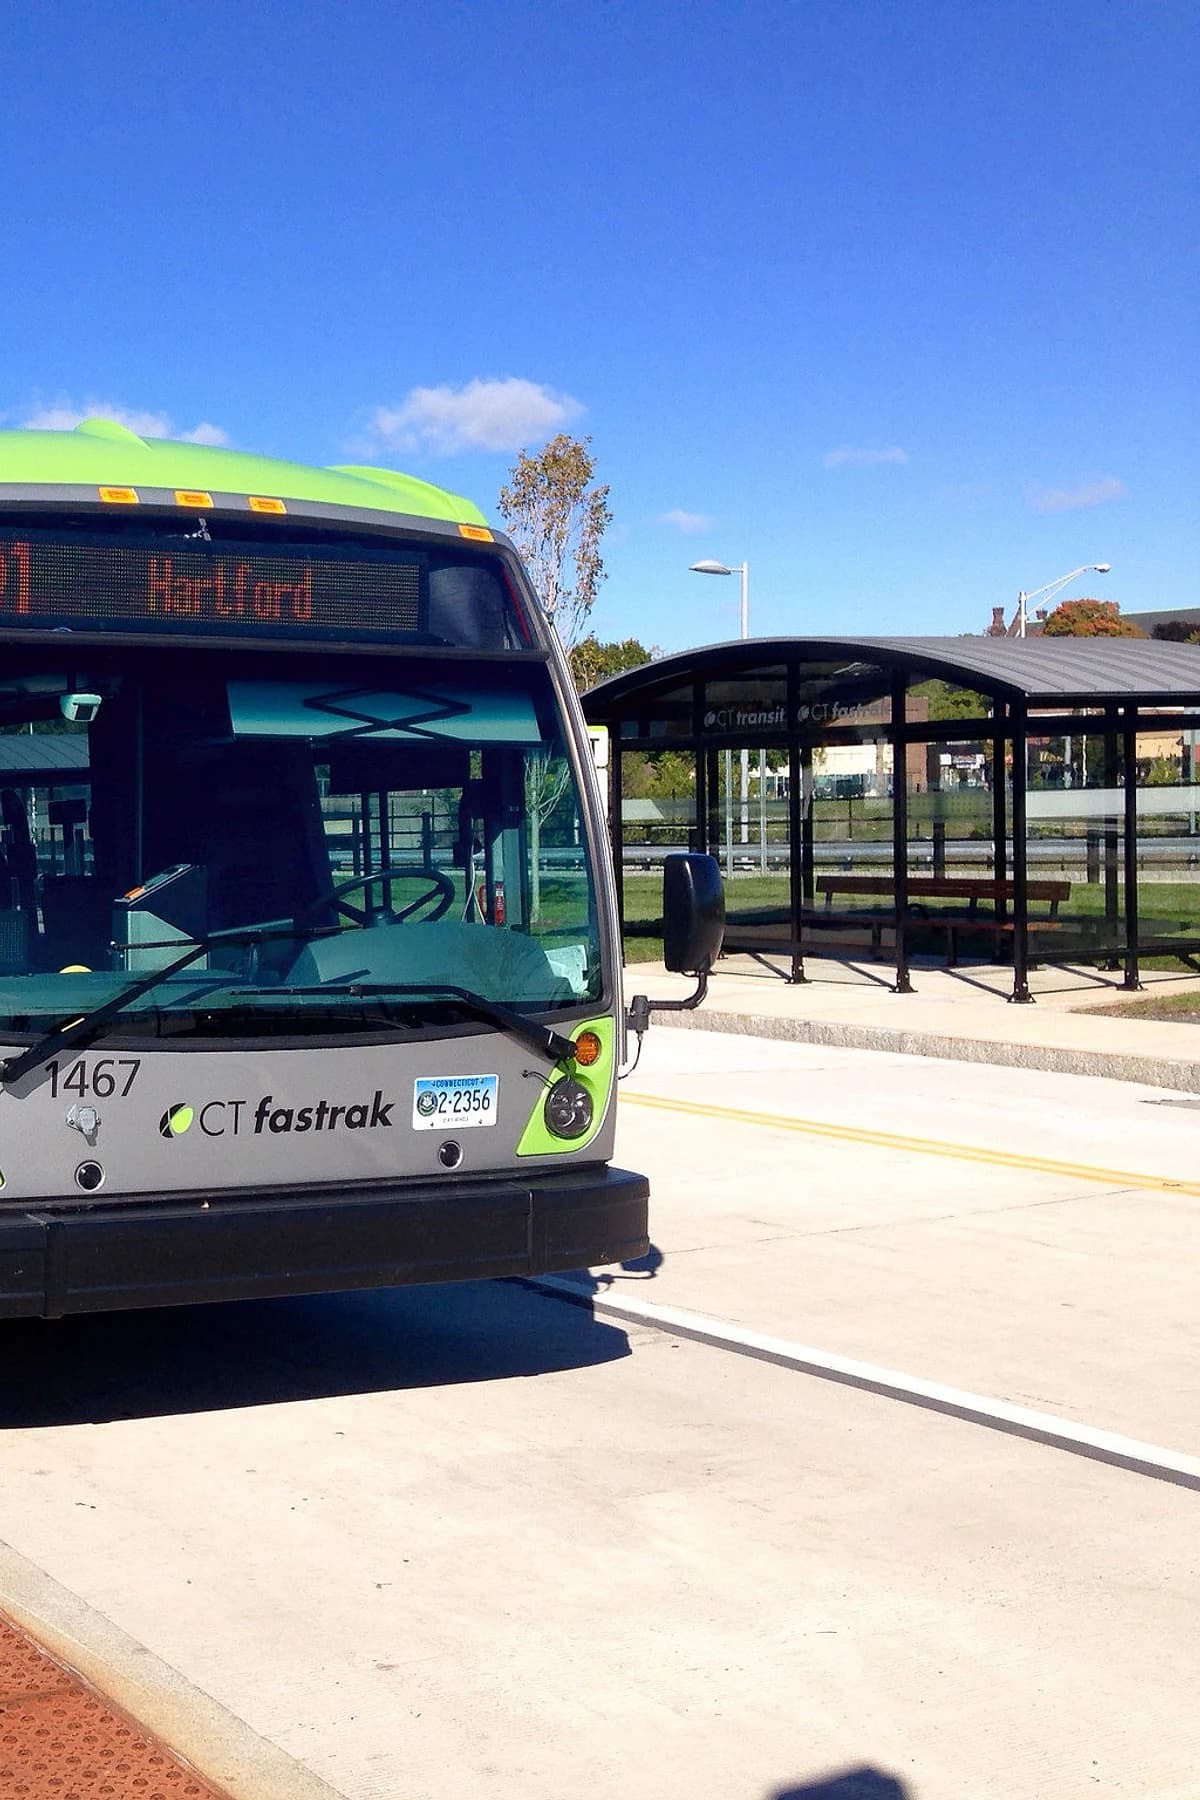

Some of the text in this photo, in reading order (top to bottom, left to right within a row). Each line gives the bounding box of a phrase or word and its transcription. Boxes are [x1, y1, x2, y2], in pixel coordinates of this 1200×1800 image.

[147, 558, 312, 621] Hartford
[716, 705, 785, 728] CT transit
[45, 1059, 141, 1098] 1467
[200, 1091, 395, 1136] CT fastrak
